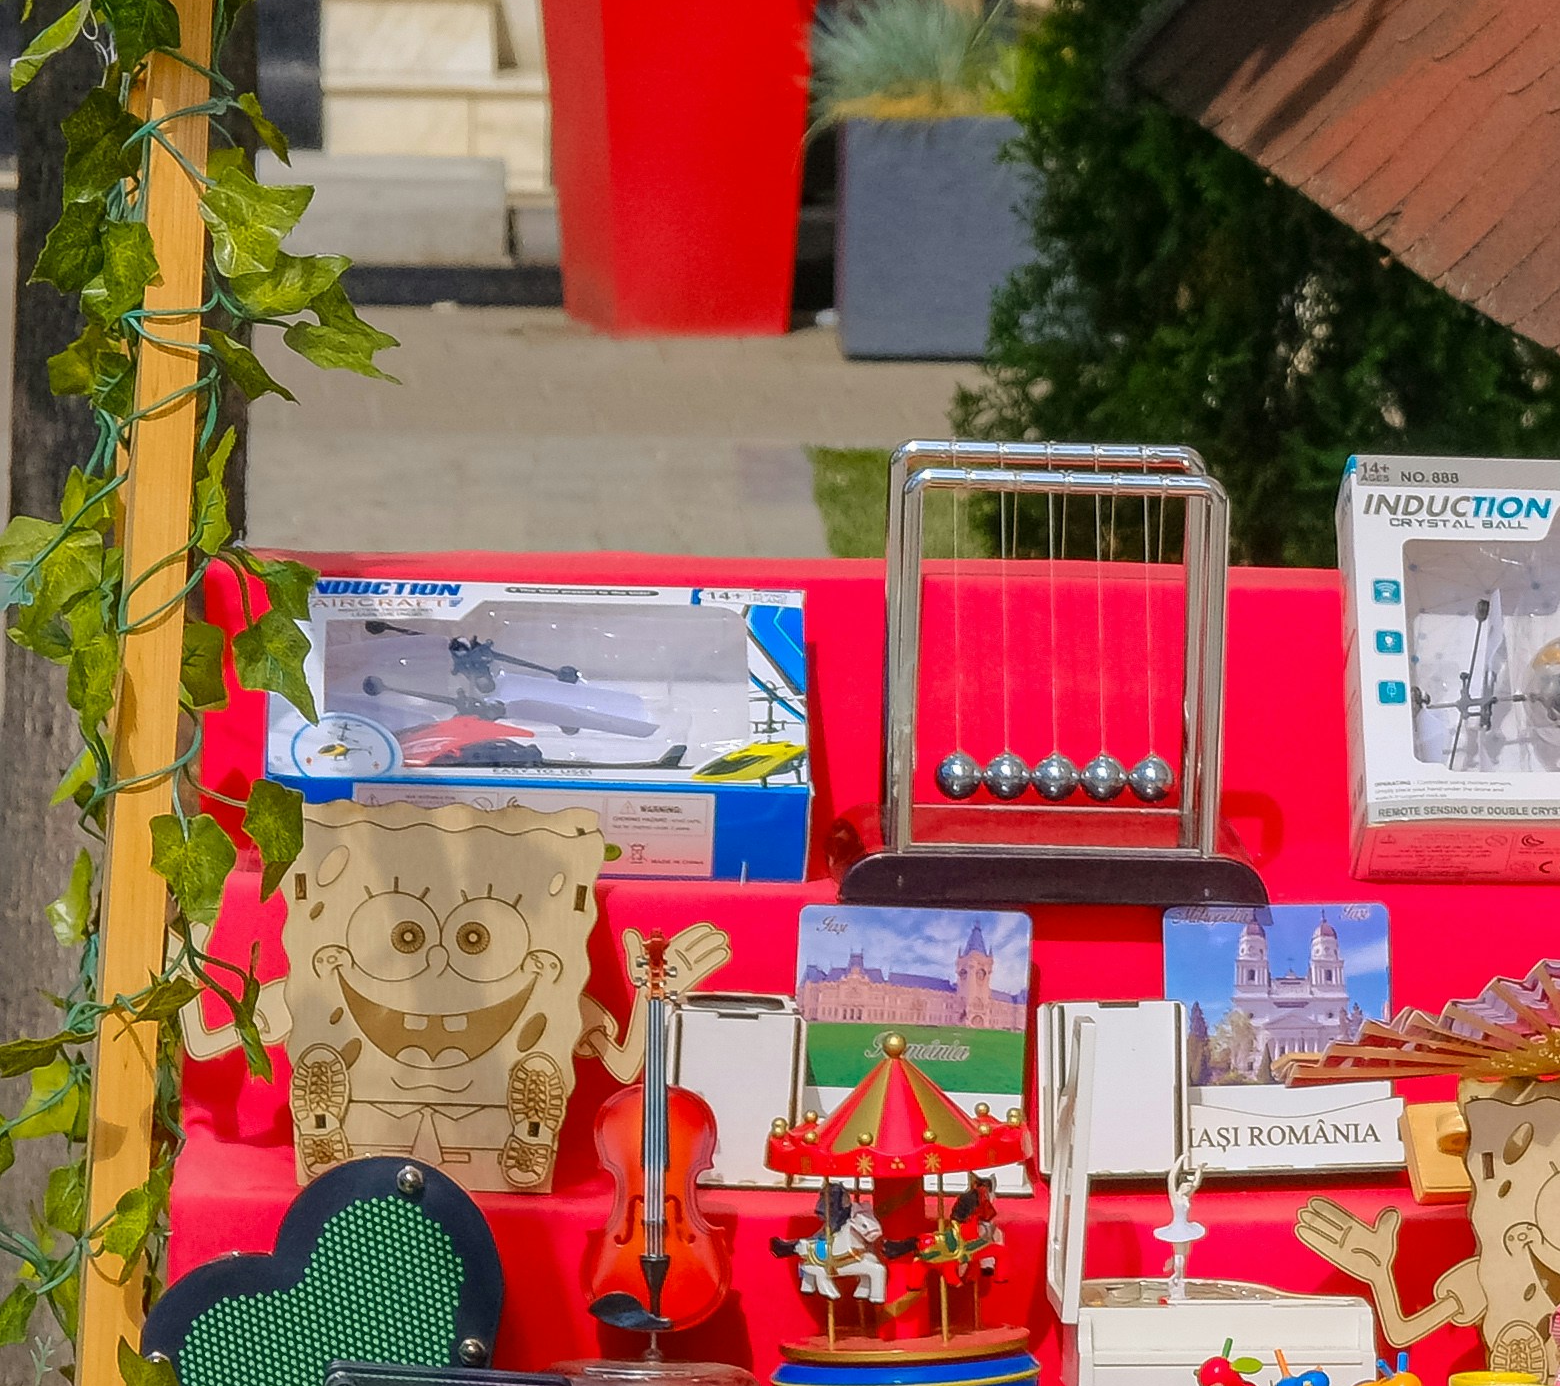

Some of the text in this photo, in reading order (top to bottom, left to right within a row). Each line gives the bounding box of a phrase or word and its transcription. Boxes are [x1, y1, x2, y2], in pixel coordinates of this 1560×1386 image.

[1361, 462, 1390, 474] 14+
[1364, 494, 1551, 519] INDUCTION
[1390, 518, 1528, 530] CRYSTAL BALL
[708, 591, 742, 601] 14+
[312, 597, 443, 608] AIRCRAFT
[1379, 806, 1420, 817] REMOTE
[1423, 806, 1468, 816] SENSING
[1487, 806, 1529, 815] DOUBLE
[864, 1030, 971, 1061] Rmânia
[1248, 1120, 1380, 1147] ROMÂNIA
